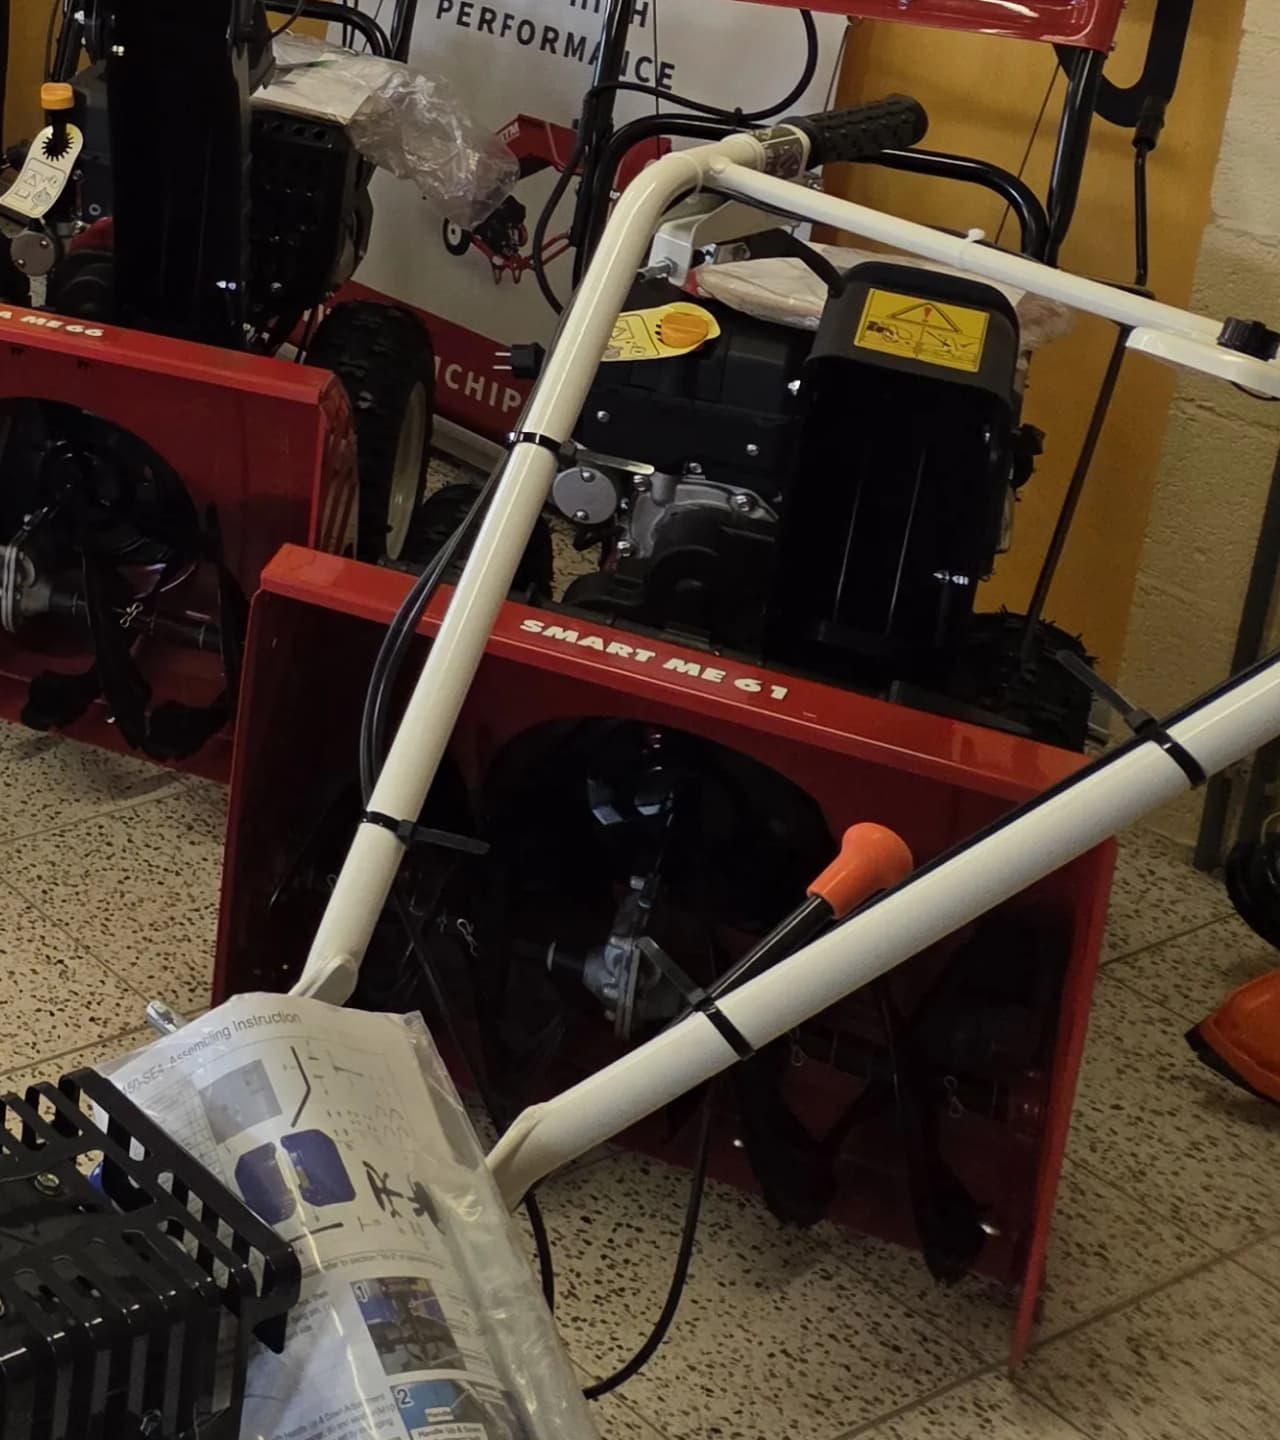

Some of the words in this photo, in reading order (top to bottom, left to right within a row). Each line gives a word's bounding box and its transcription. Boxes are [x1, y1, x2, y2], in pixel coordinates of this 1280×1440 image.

[20, 315, 64, 329] ME
[65, 324, 105, 337] 66
[520, 619, 656, 663] SMART
[662, 657, 727, 683] ME
[734, 677, 789, 700] 61
[234, 1011, 302, 1033] Instruction
[396, 1388, 414, 1408] 2
